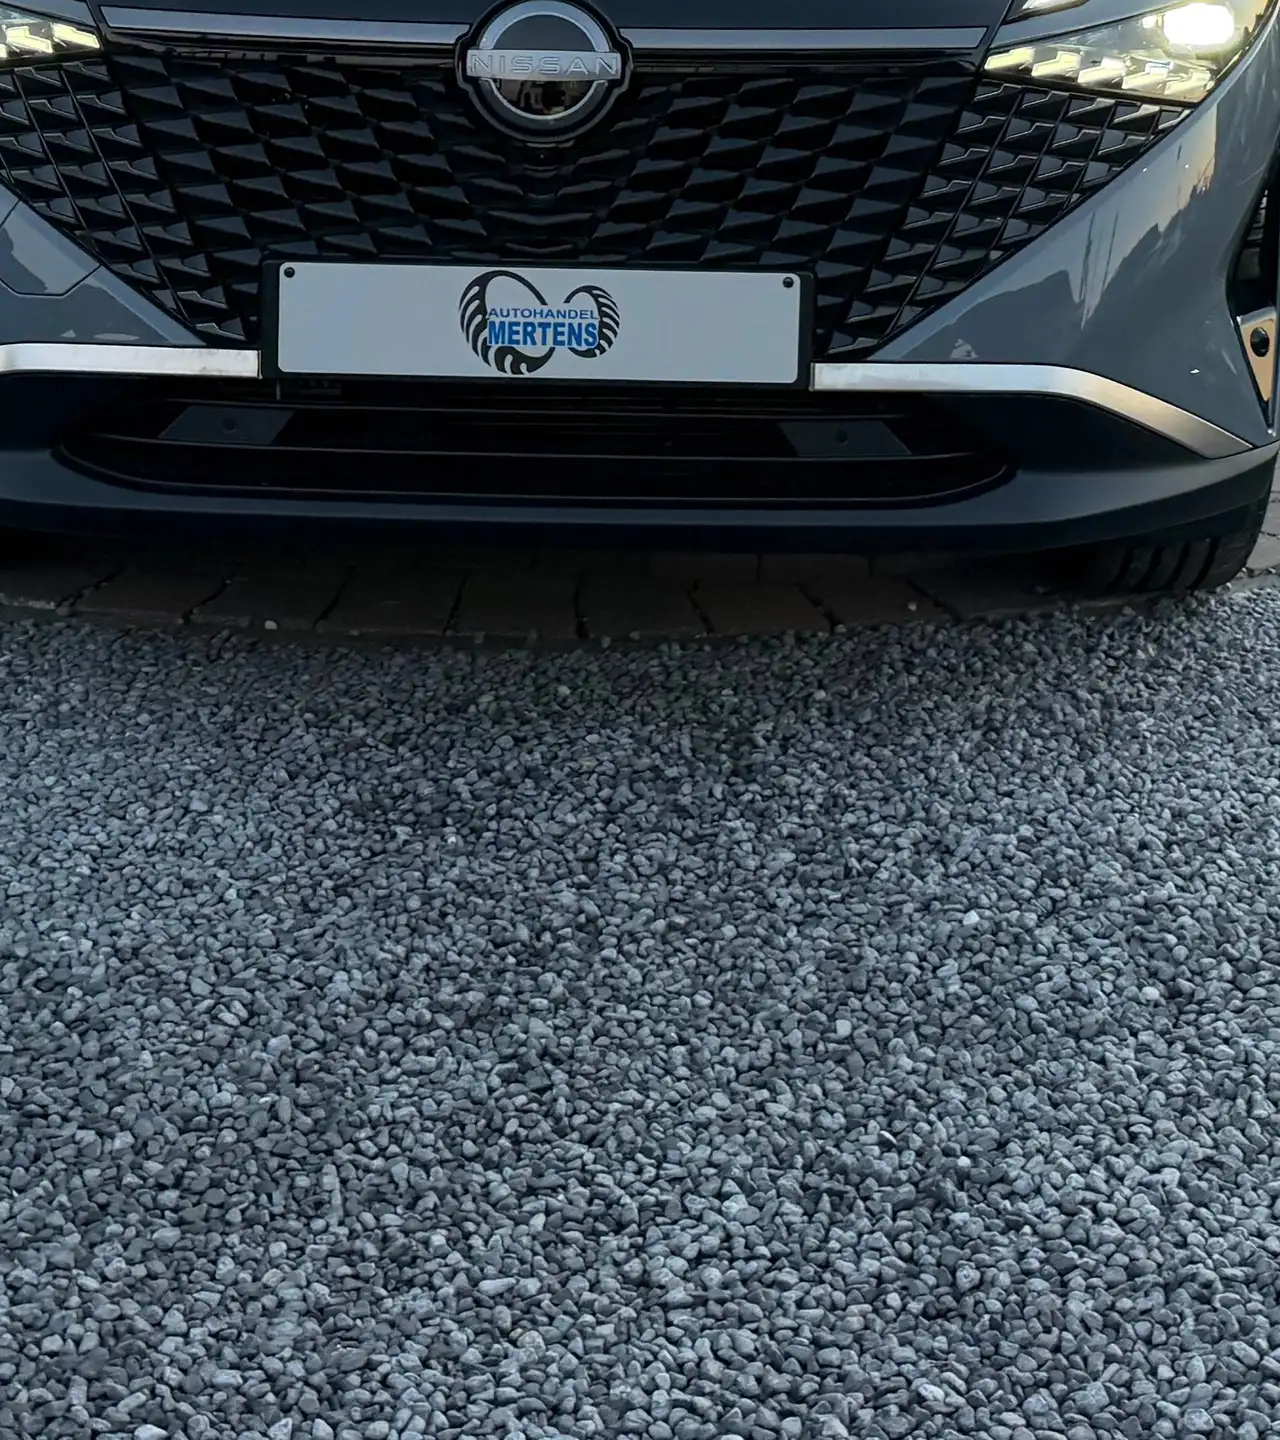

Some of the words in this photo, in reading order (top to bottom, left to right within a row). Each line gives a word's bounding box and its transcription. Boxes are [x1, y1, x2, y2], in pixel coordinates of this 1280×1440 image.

[471, 55, 618, 76] NISSAN
[488, 307, 598, 320] AUTOHANDEL
[488, 321, 599, 346] MERTENS
